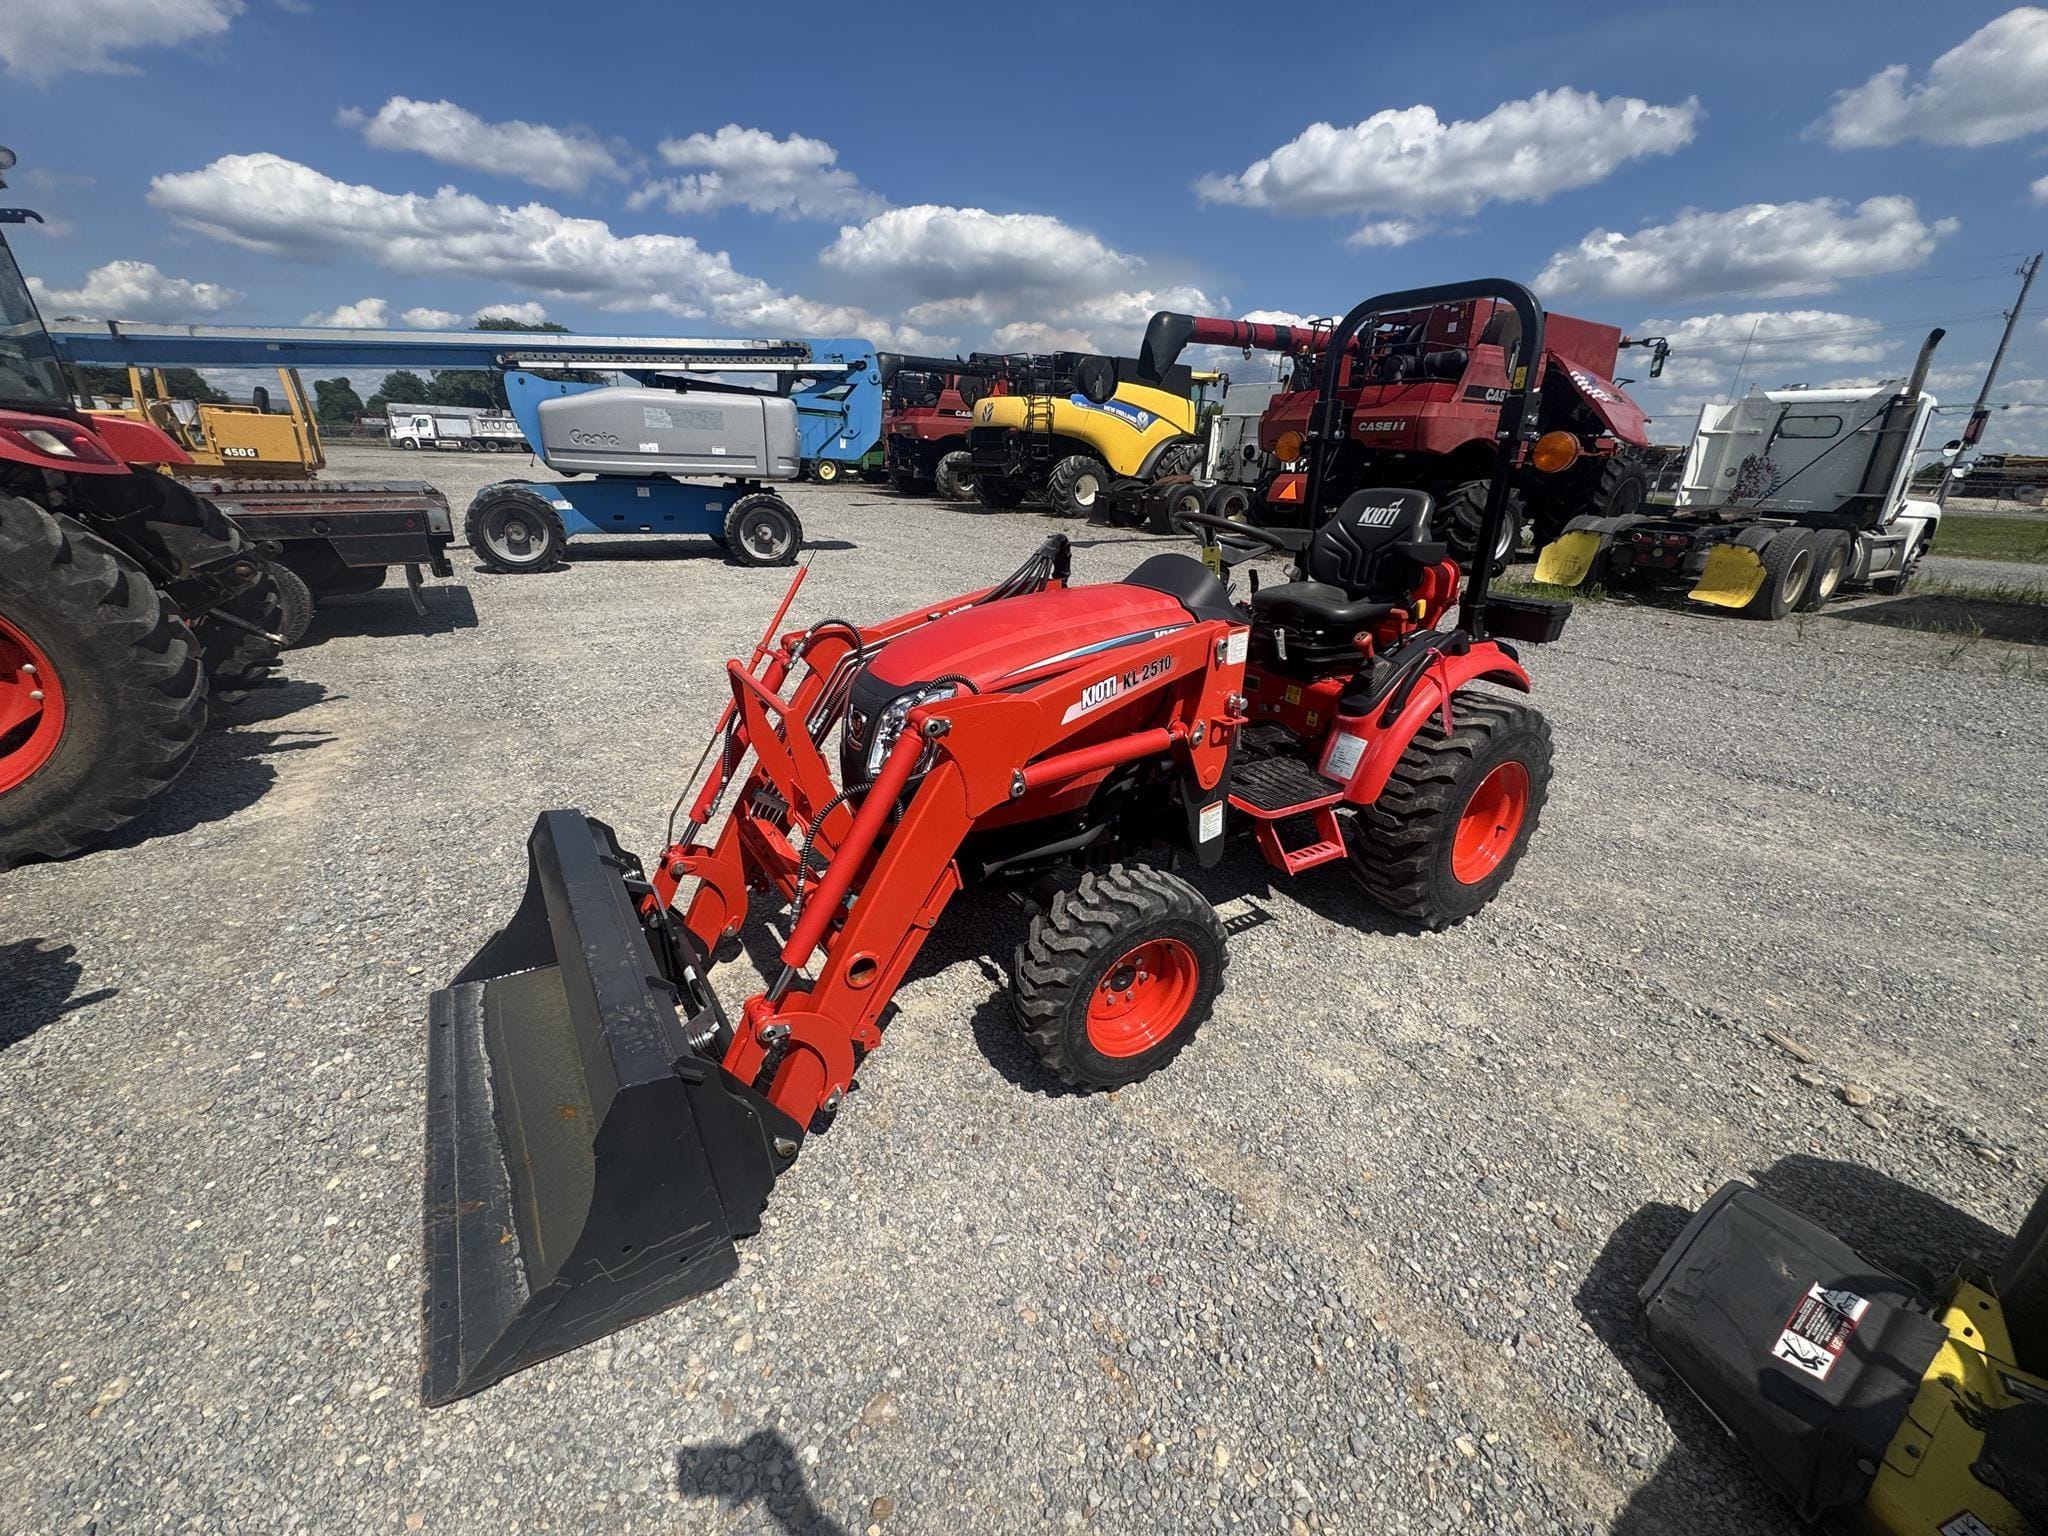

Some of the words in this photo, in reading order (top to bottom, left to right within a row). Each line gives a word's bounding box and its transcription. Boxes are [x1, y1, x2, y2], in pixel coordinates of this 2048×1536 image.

[1485, 388, 1508, 402] CAS
[1116, 408, 1137, 423] HOLLAND
[481, 420, 519, 431] ROC
[569, 428, 620, 447] Genie
[1358, 506, 1401, 525] KIOTI
[1081, 675, 1117, 710] KIOTI
[1123, 670, 1139, 690] KL
[1142, 655, 1171, 681] 2510
